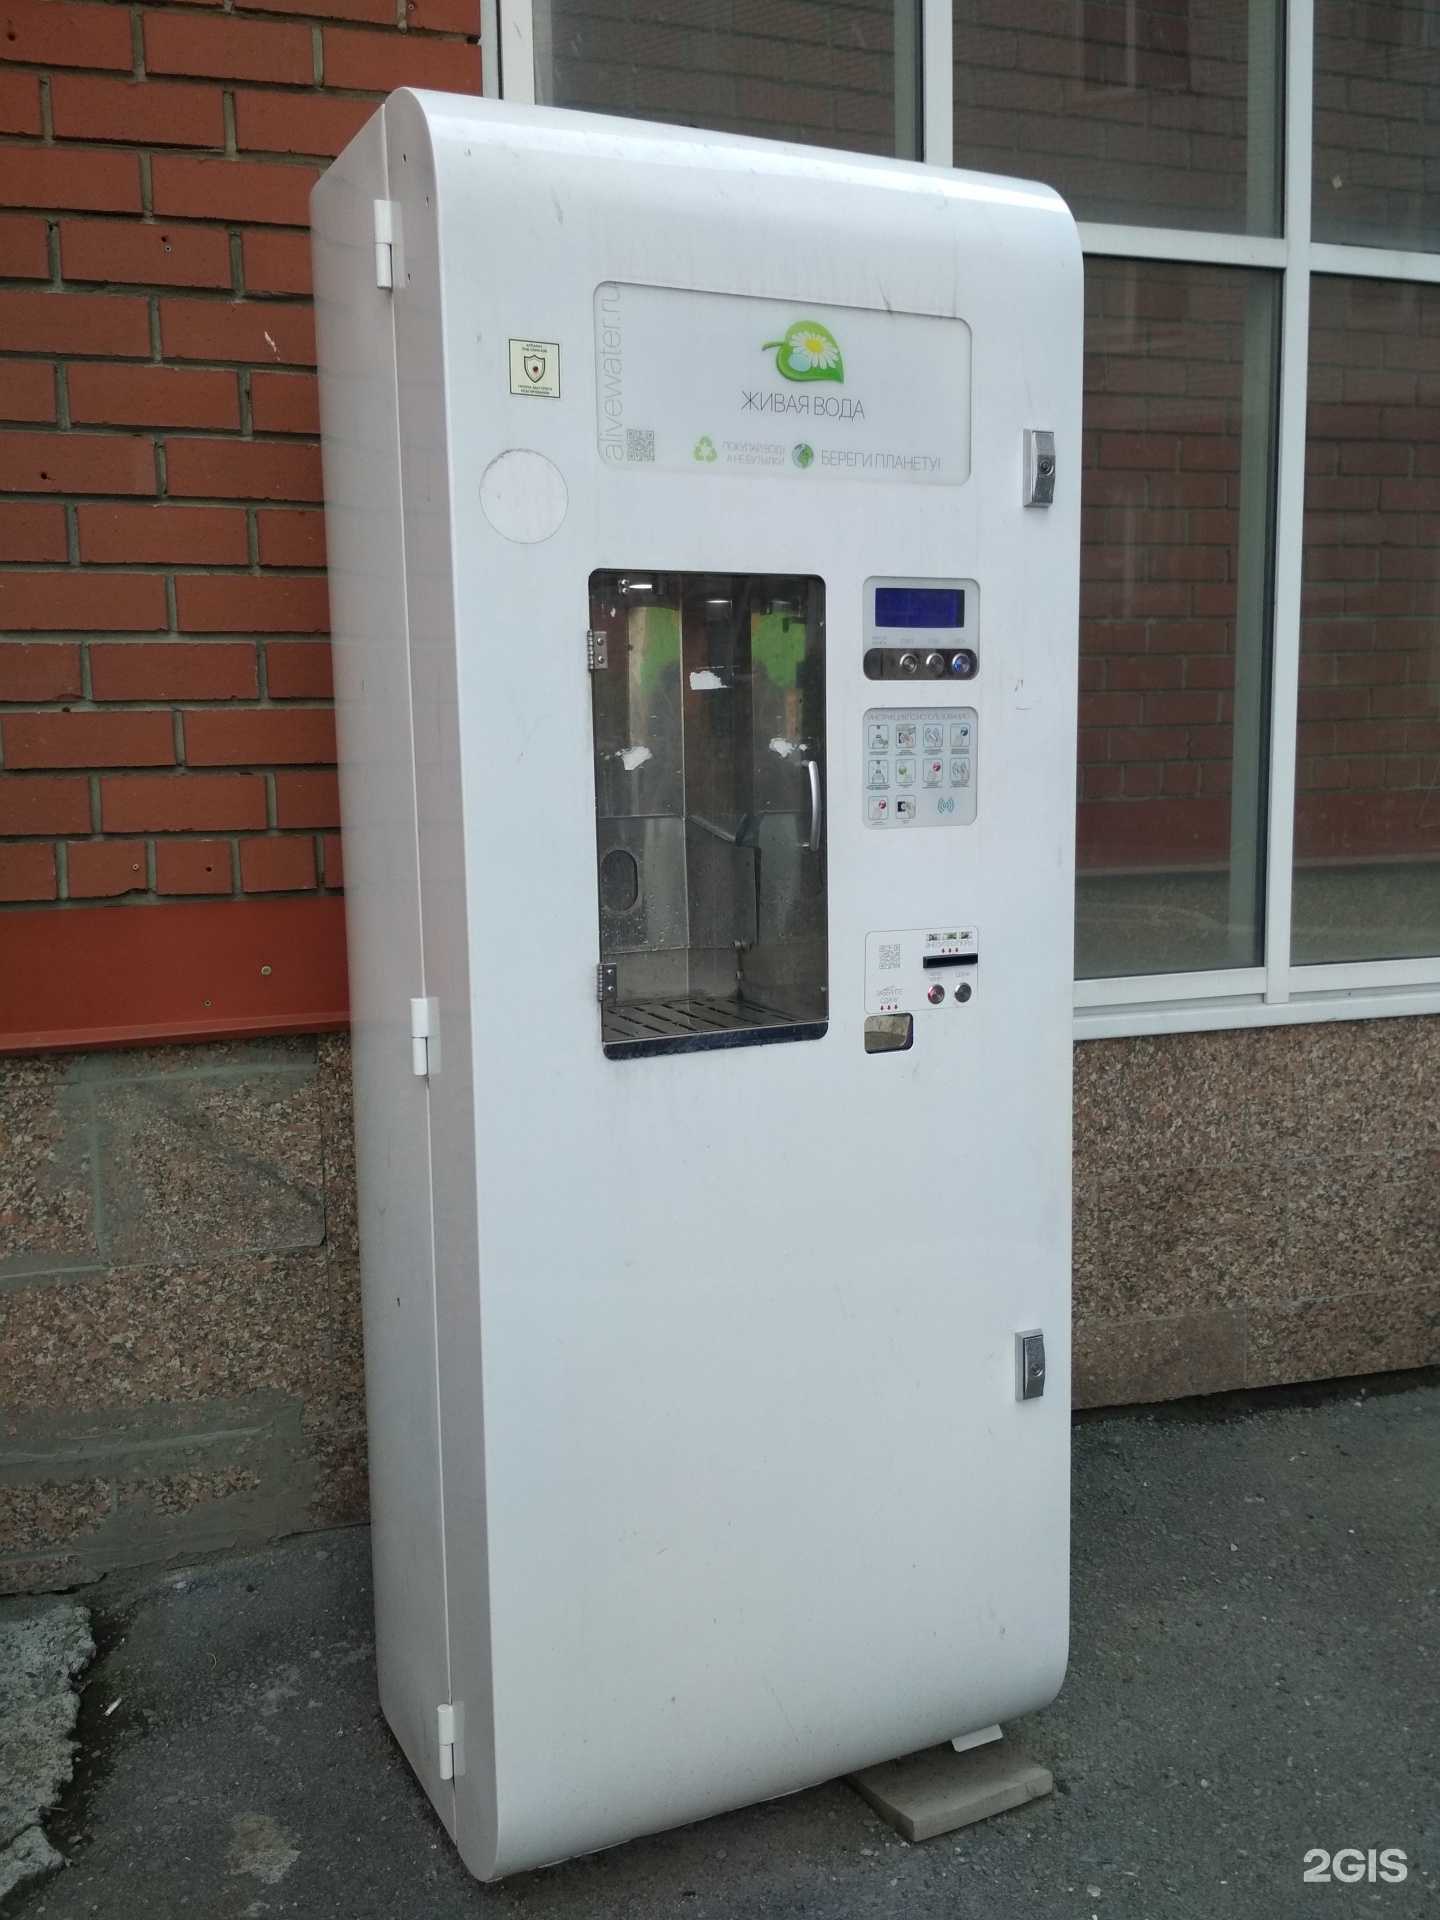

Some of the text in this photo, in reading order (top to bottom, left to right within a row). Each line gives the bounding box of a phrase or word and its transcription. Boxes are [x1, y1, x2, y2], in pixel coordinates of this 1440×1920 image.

[600, 286, 624, 467] alivewater.ru
[741, 390, 865, 422] ЖИВАЯ ВОДА
[821, 450, 941, 472] БЕРЕГИ ПЛАНЕТУ!
